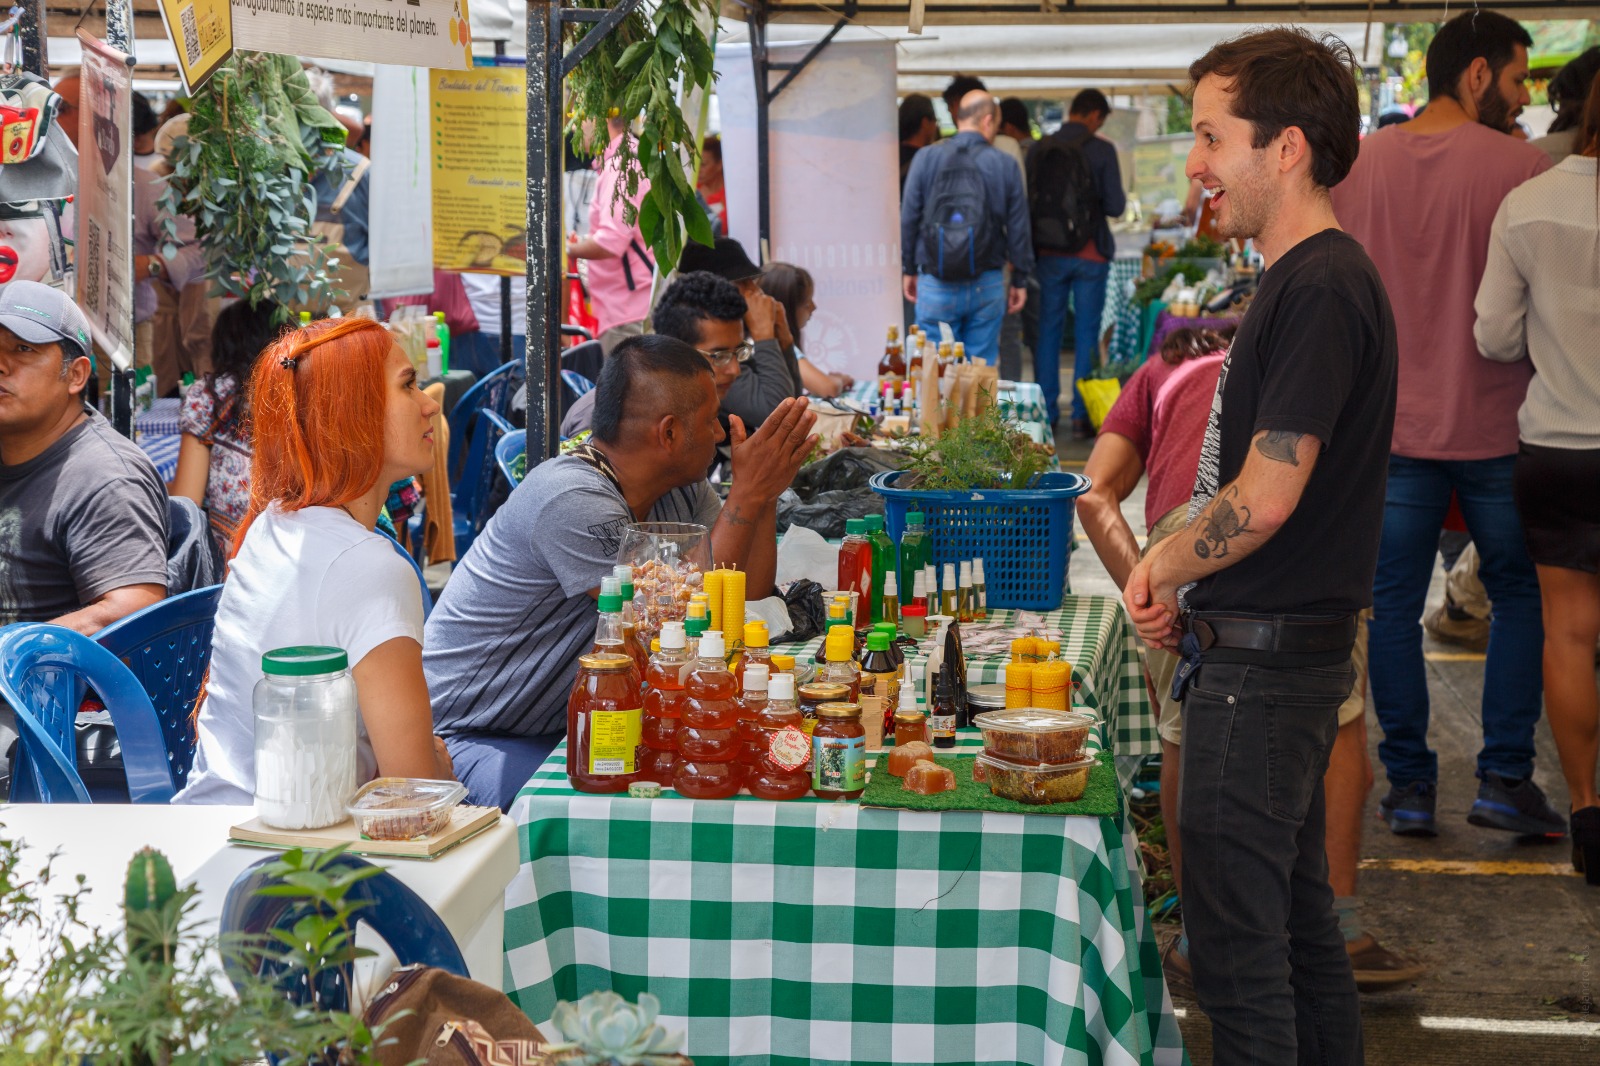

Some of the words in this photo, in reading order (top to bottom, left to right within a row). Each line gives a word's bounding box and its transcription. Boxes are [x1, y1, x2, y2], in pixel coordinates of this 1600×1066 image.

[306, 0, 333, 26] especie
[336, 3, 351, 25] más
[353, 3, 394, 33] importante
[397, 9, 407, 32] del
